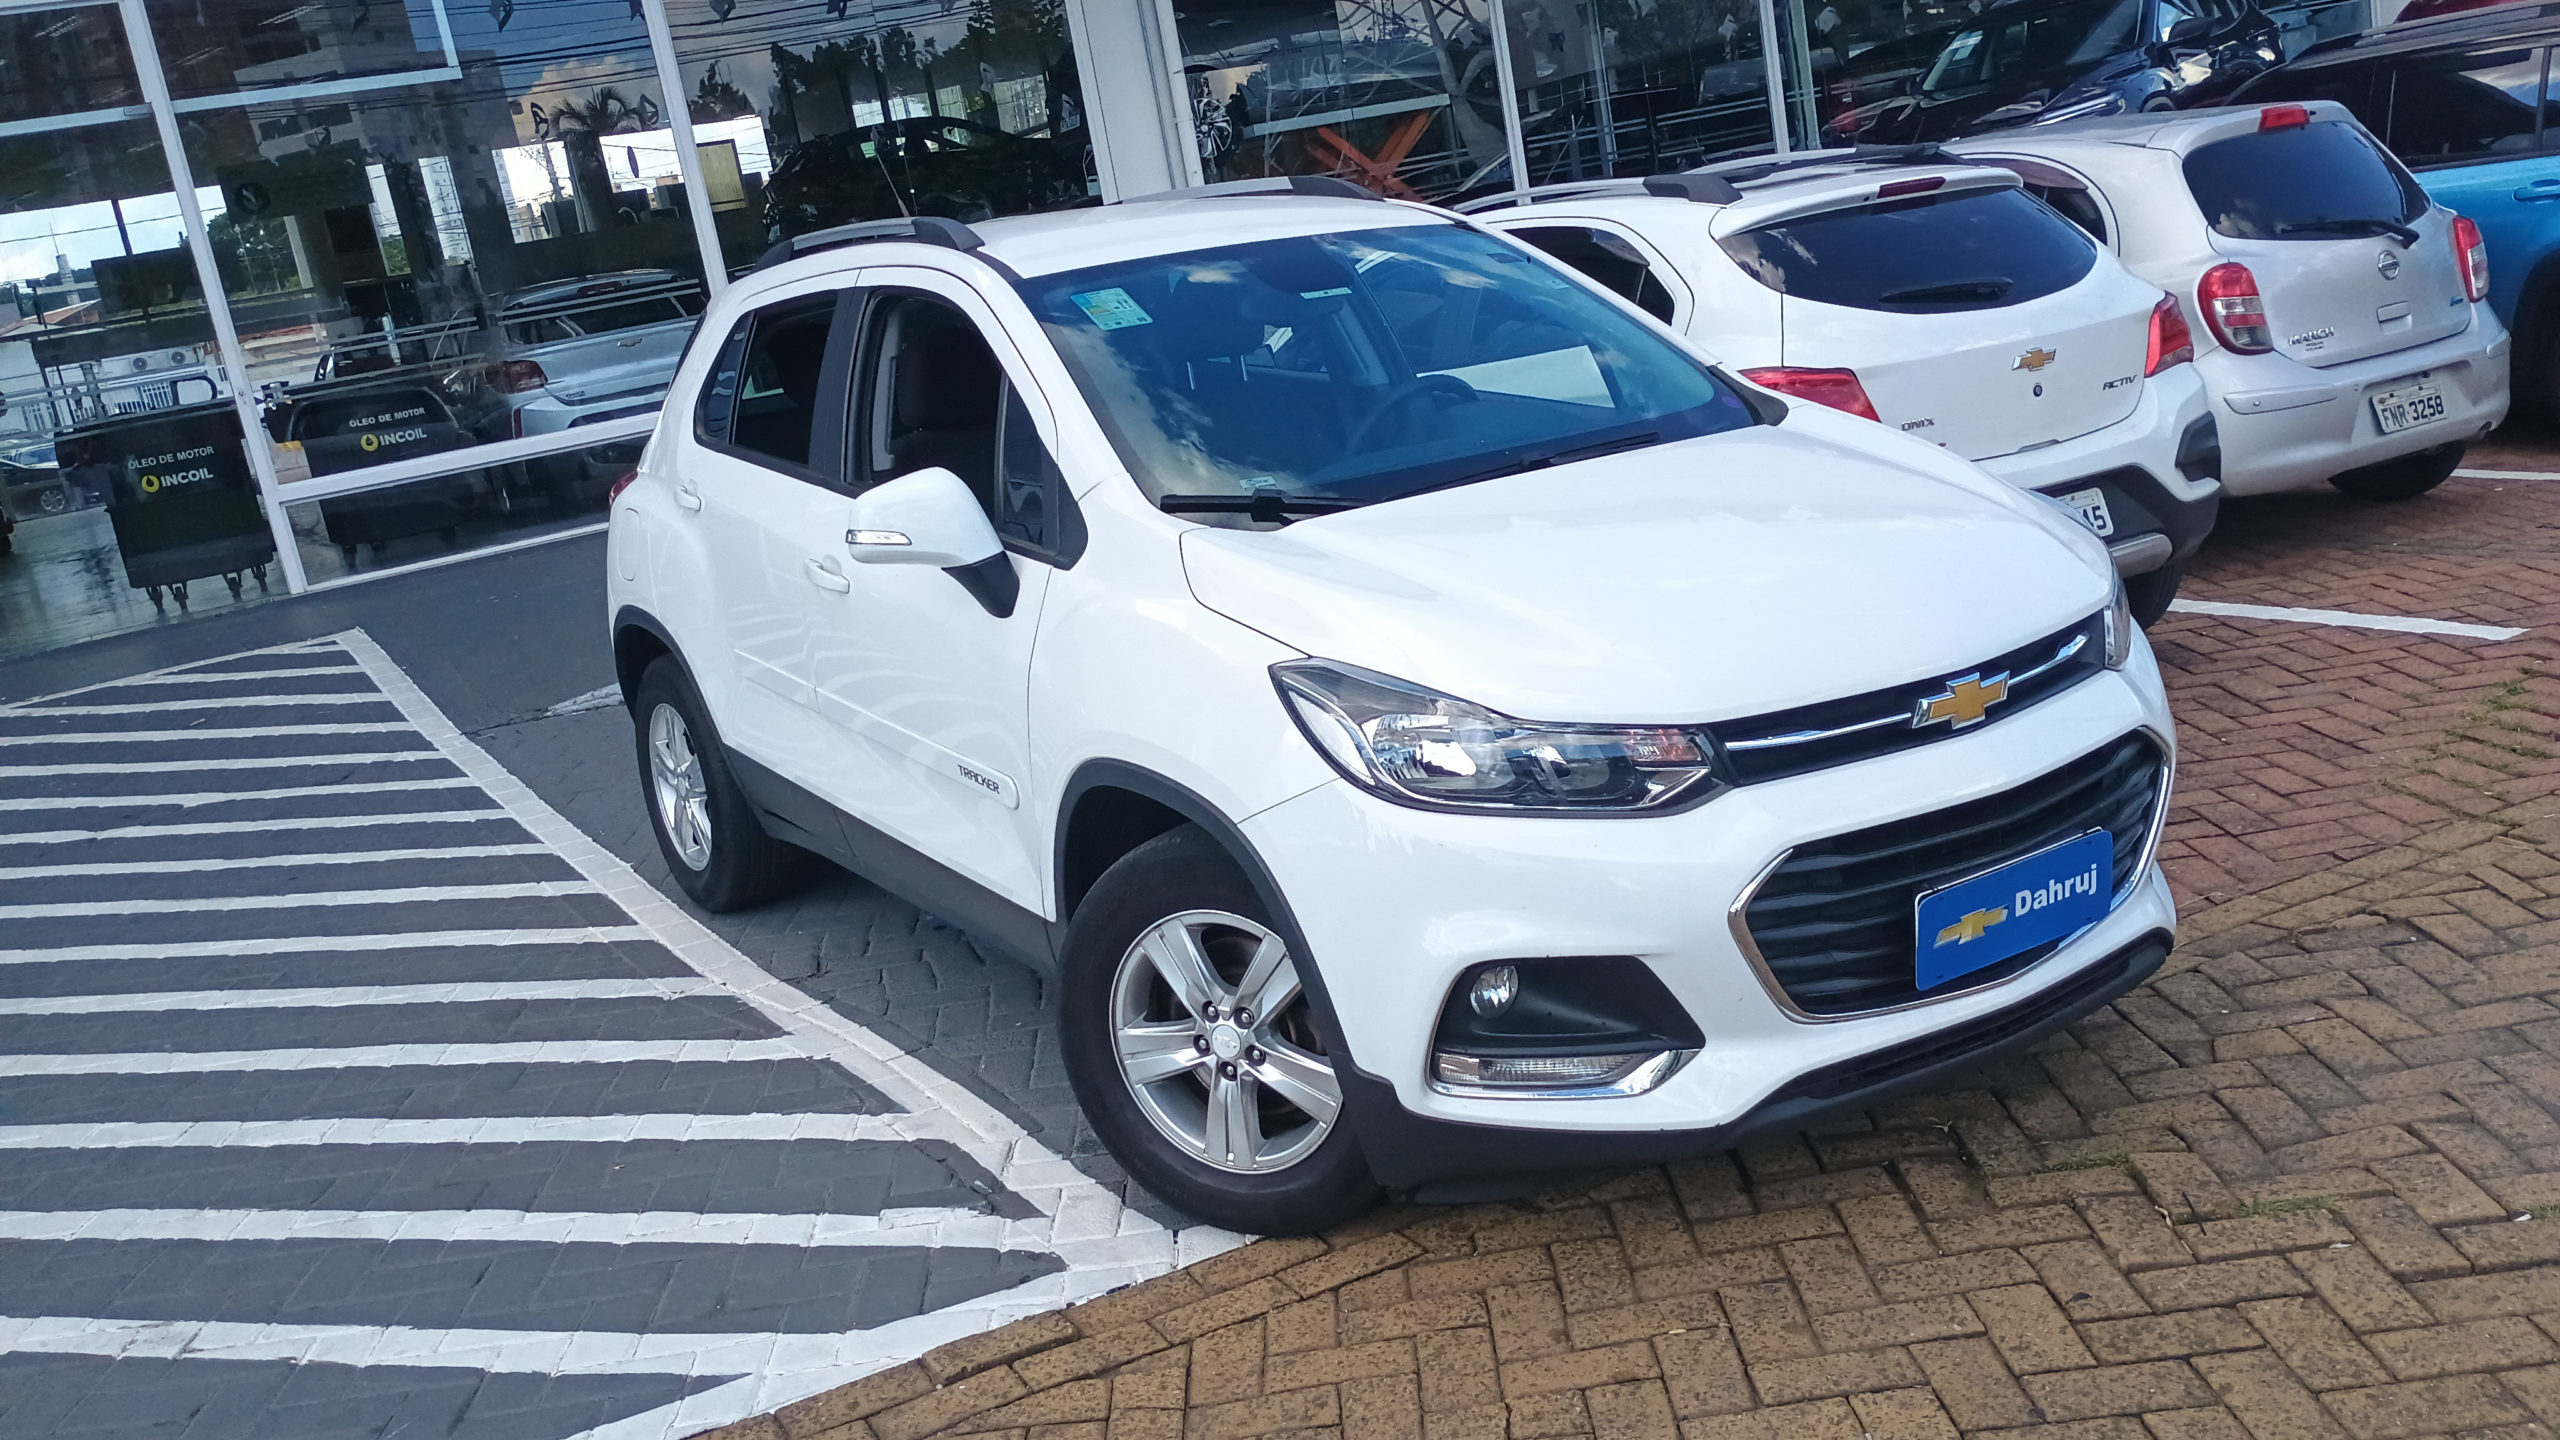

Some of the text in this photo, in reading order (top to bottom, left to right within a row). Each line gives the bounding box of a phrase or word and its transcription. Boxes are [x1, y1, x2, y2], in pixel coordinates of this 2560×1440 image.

[2102, 374, 2138, 391] ACTIV
[378, 413, 392, 423] DE
[394, 407, 426, 420] MOTOR
[379, 428, 428, 446] INCOIL
[127, 446, 215, 470] ÓLEO DE MOTOR
[160, 467, 214, 488] INCOIL
[957, 764, 1000, 795] TRACKER
[2015, 863, 2098, 918] Dahruj
